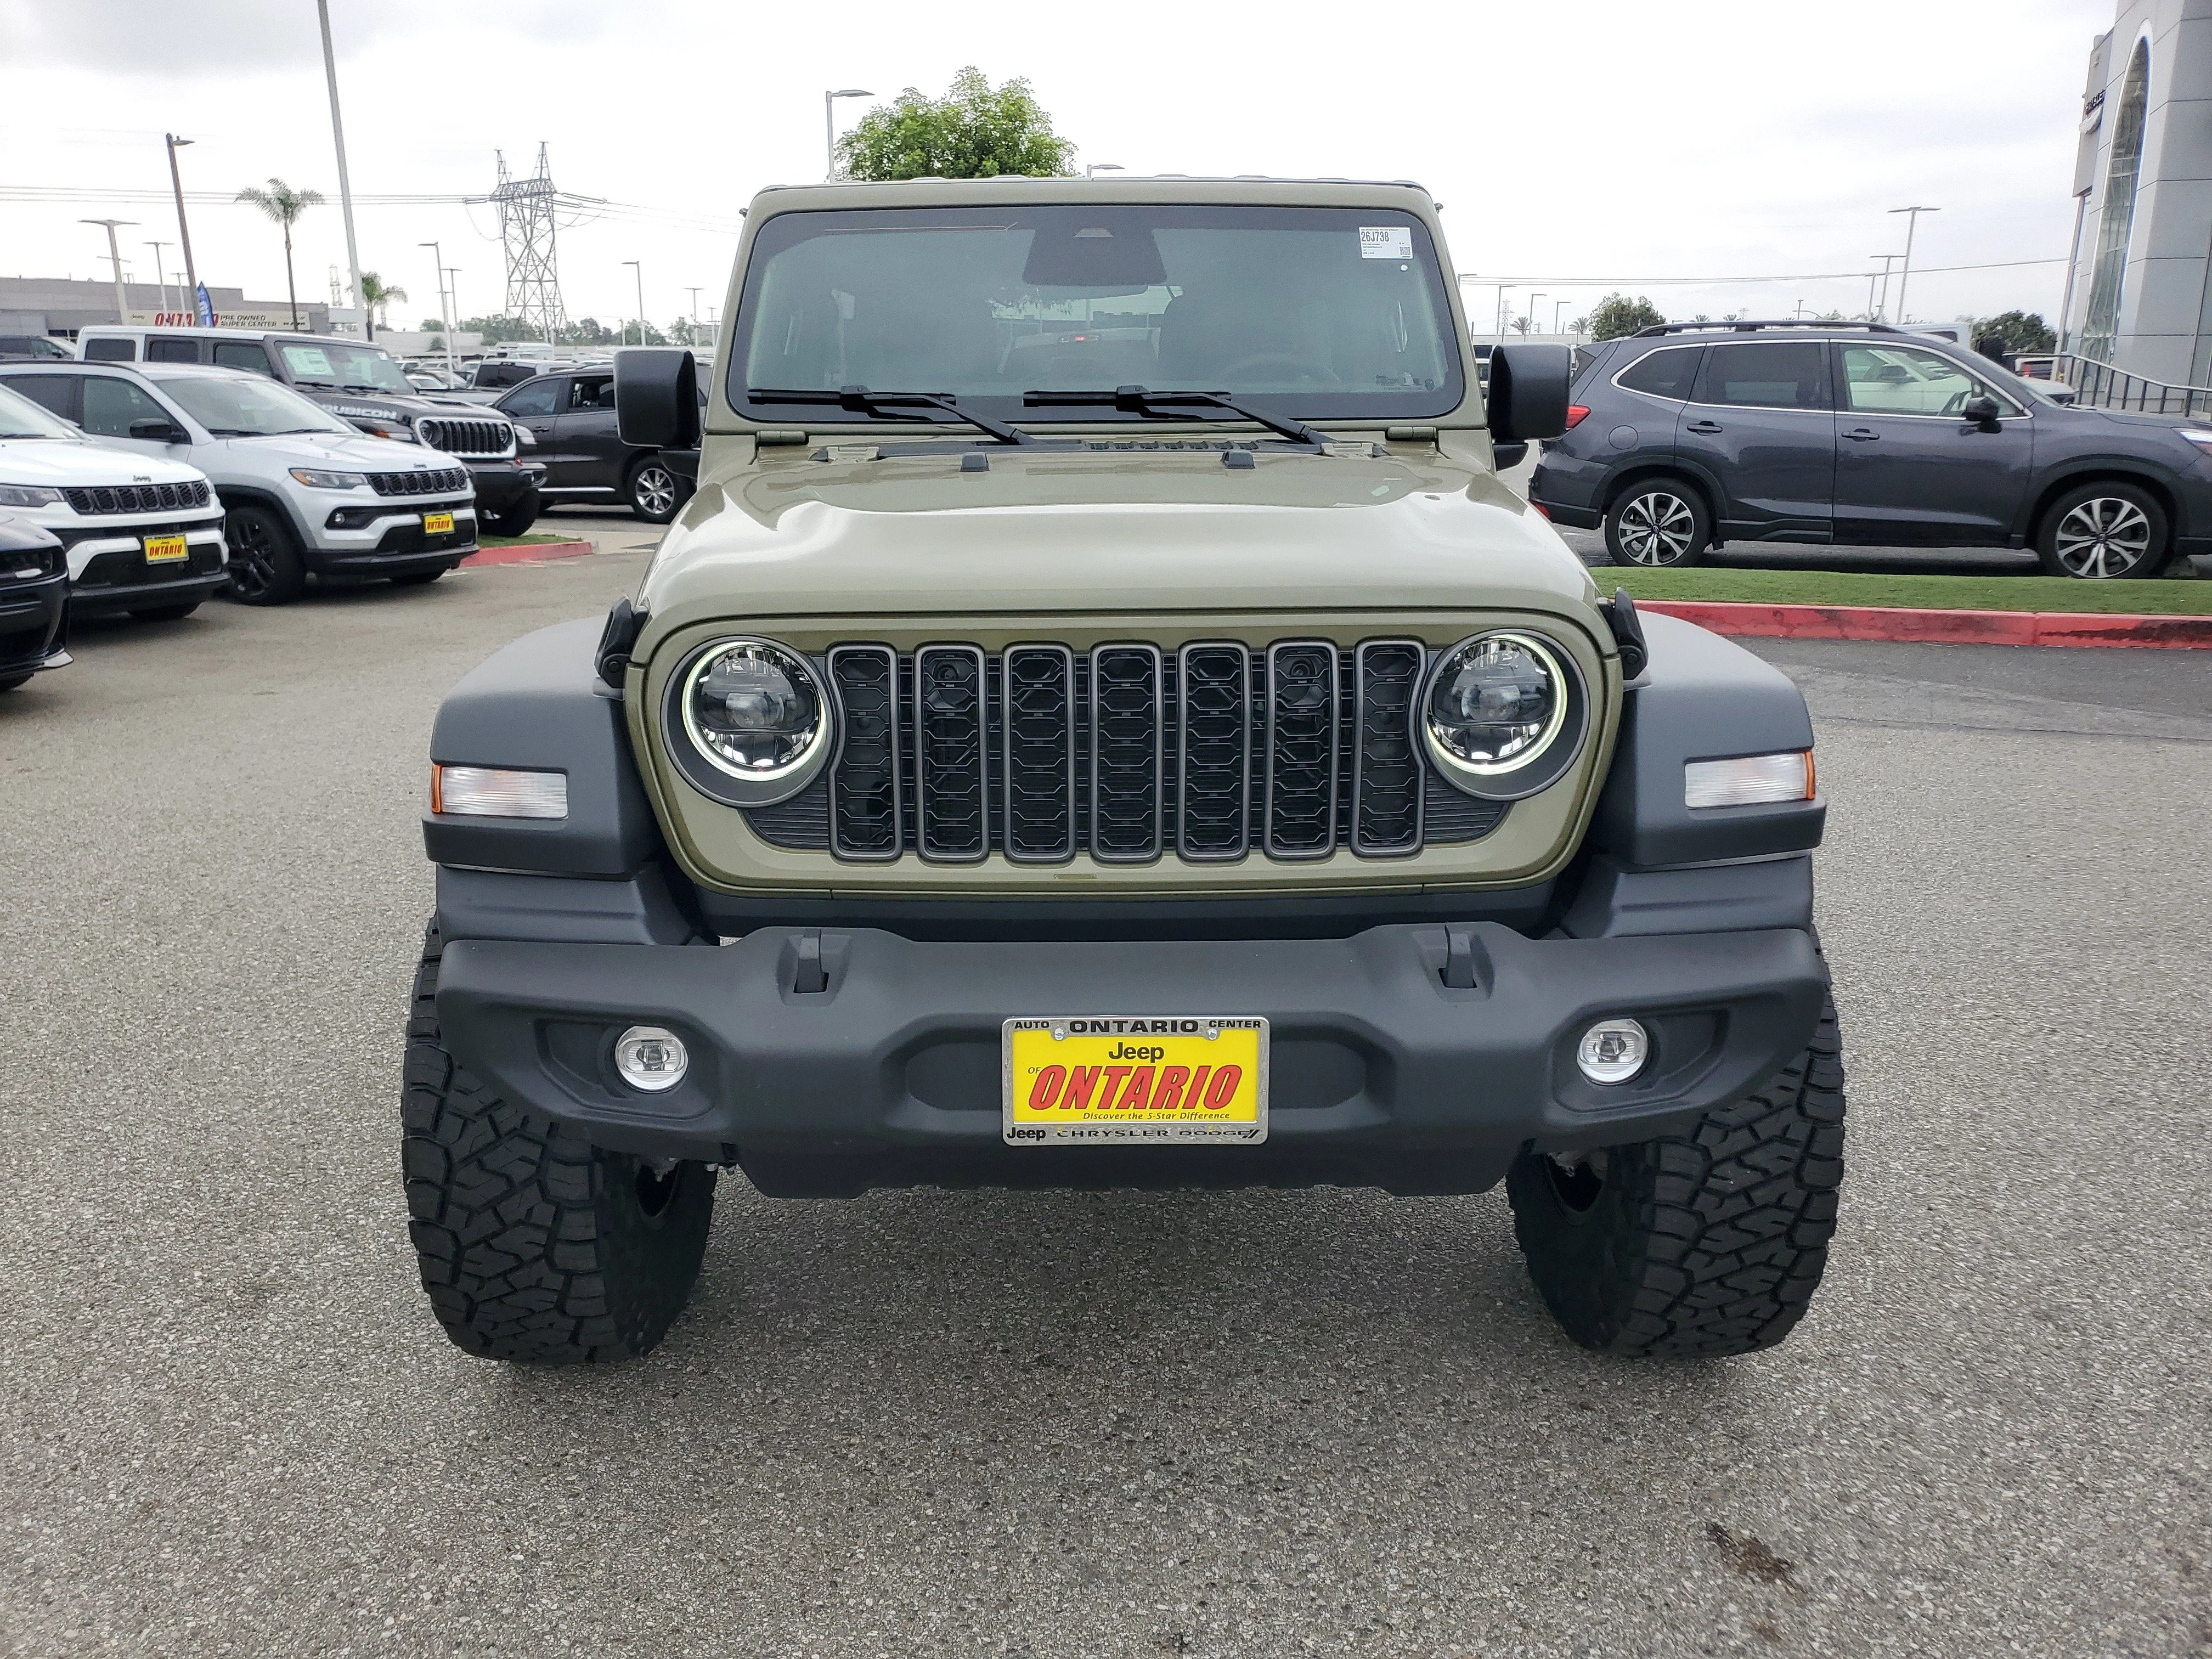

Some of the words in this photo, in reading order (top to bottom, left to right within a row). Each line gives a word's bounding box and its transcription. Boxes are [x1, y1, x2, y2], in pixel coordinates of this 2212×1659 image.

[1361, 231, 1390, 242] 26J738
[149, 544, 182, 556] ONTARIO
[1015, 1021, 1049, 1029] AUTO
[1070, 1020, 1199, 1033] ONTARIO
[1209, 1020, 1261, 1028] CENTER
[1108, 1042, 1165, 1063] Jeep
[1028, 1064, 1243, 1110] ONTARIO
[1180, 1111, 1231, 1121] Difference
[1007, 1127, 1046, 1141] Jeep
[1057, 1130, 1169, 1138] CHRYSLER
